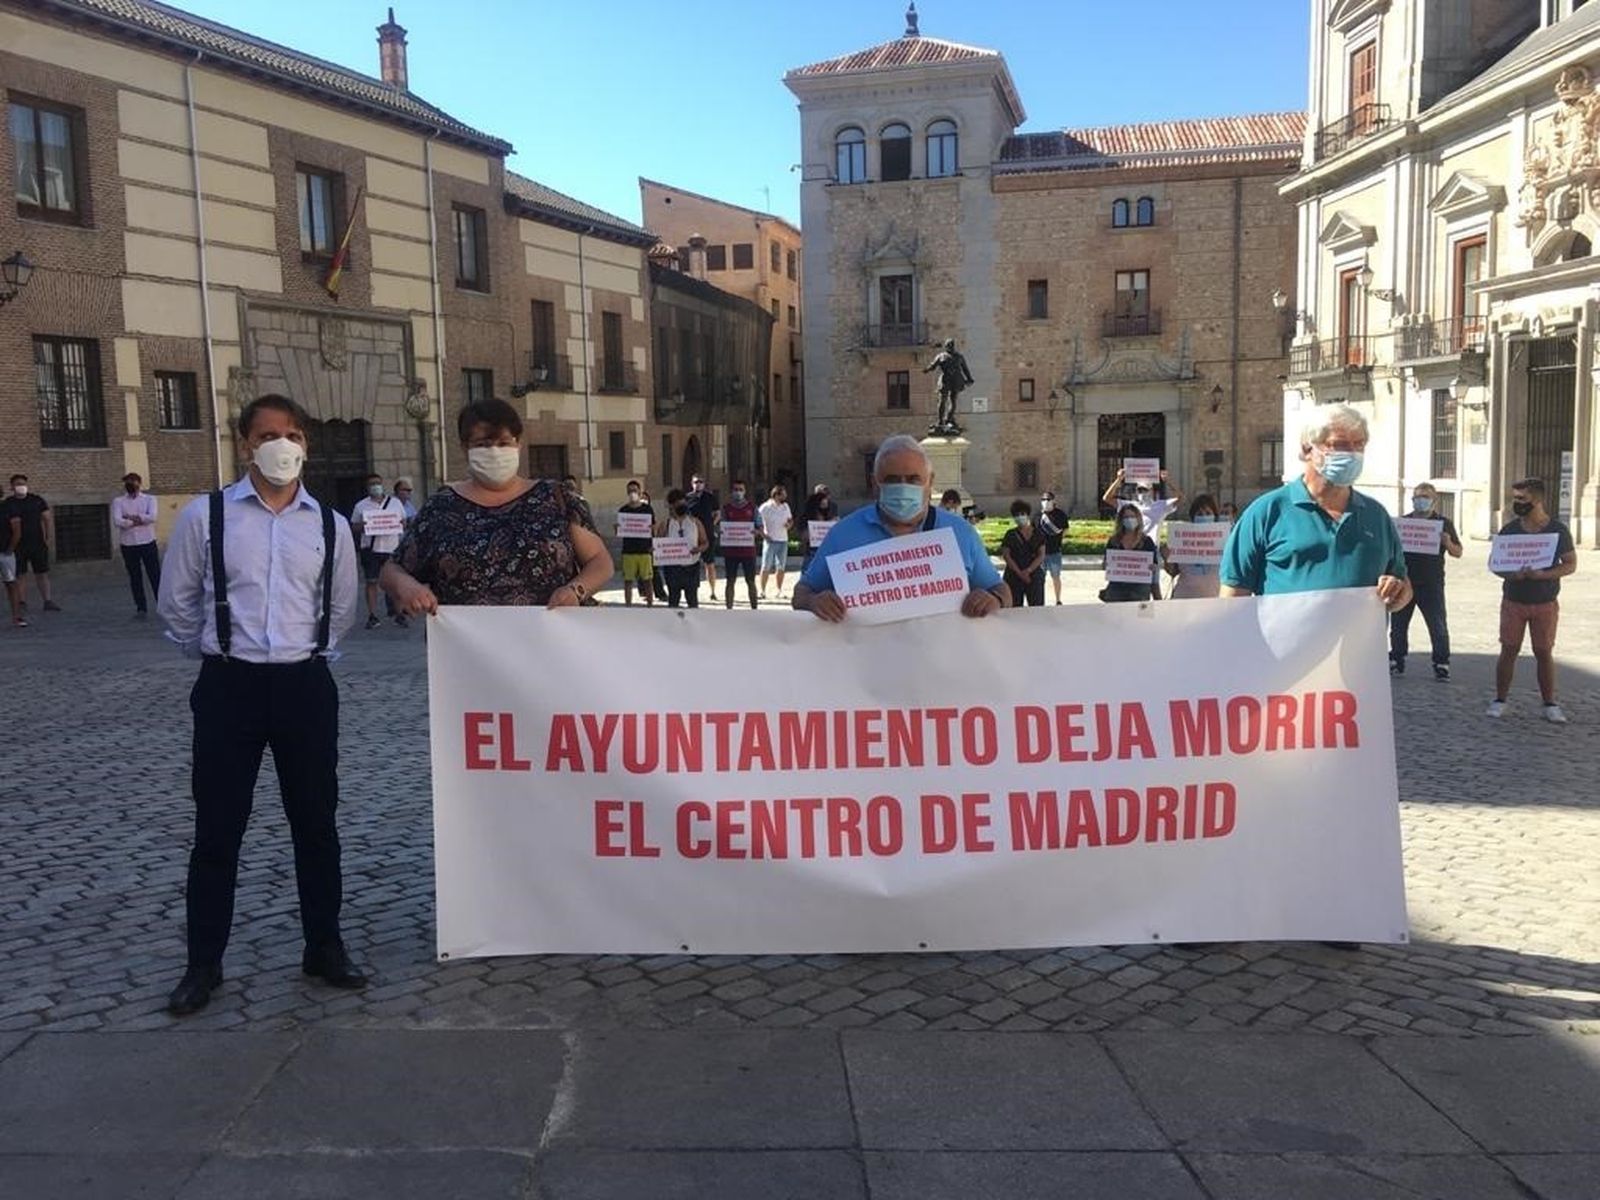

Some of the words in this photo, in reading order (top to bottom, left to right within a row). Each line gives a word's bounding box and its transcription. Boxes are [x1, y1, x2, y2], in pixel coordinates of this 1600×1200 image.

[845, 561, 860, 573] EL
[861, 543, 944, 570] AYUNTAMIENTO
[867, 569, 895, 586] DEJA
[895, 563, 933, 581] MORIR
[844, 595, 857, 609] EL
[858, 585, 903, 607] CENTRO
[903, 584, 919, 600] DE
[919, 577, 964, 597] MADRID
[463, 711, 531, 772] EL
[546, 706, 999, 775] AYUNTAMIENTO
[1014, 701, 1157, 764] DEJA
[1169, 690, 1360, 758] MORIR
[594, 799, 660, 858] EL
[675, 795, 904, 861] CENTRO
[920, 792, 994, 855] DE
[1008, 781, 1238, 852] MADRID
